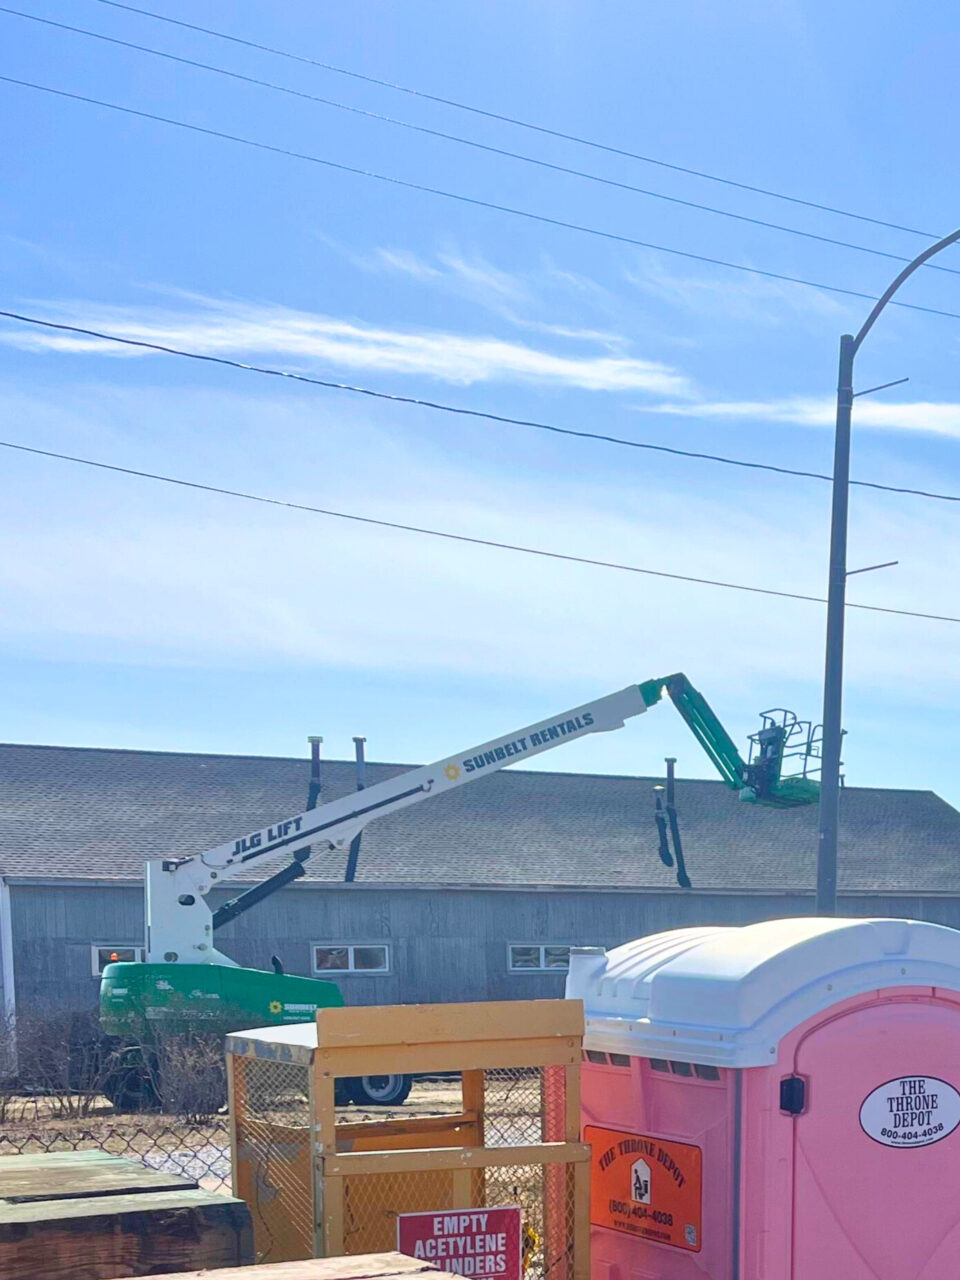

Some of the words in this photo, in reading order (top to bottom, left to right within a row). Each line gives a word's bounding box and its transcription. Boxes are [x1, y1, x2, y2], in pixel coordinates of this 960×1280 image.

[463, 737, 528, 773] SUNBELT
[529, 712, 595, 747] RENTALS
[232, 832, 262, 857] JLG
[267, 815, 303, 842] LIFT
[900, 1079, 926, 1096] THE
[886, 1094, 939, 1113] THRONE
[893, 1110, 933, 1128] DEPOT
[880, 1122, 944, 1140] 800-404-4038
[599, 1146, 617, 1172] THE
[618, 1139, 656, 1158] THRONE
[657, 1147, 686, 1188] DEPOT
[433, 1213, 489, 1236] EMPTY
[608, 1199, 631, 1219] (800)
[631, 1205, 674, 1227] 404-4038
[413, 1232, 507, 1259] ACETYLENE
[431, 1254, 507, 1276] INDERS
